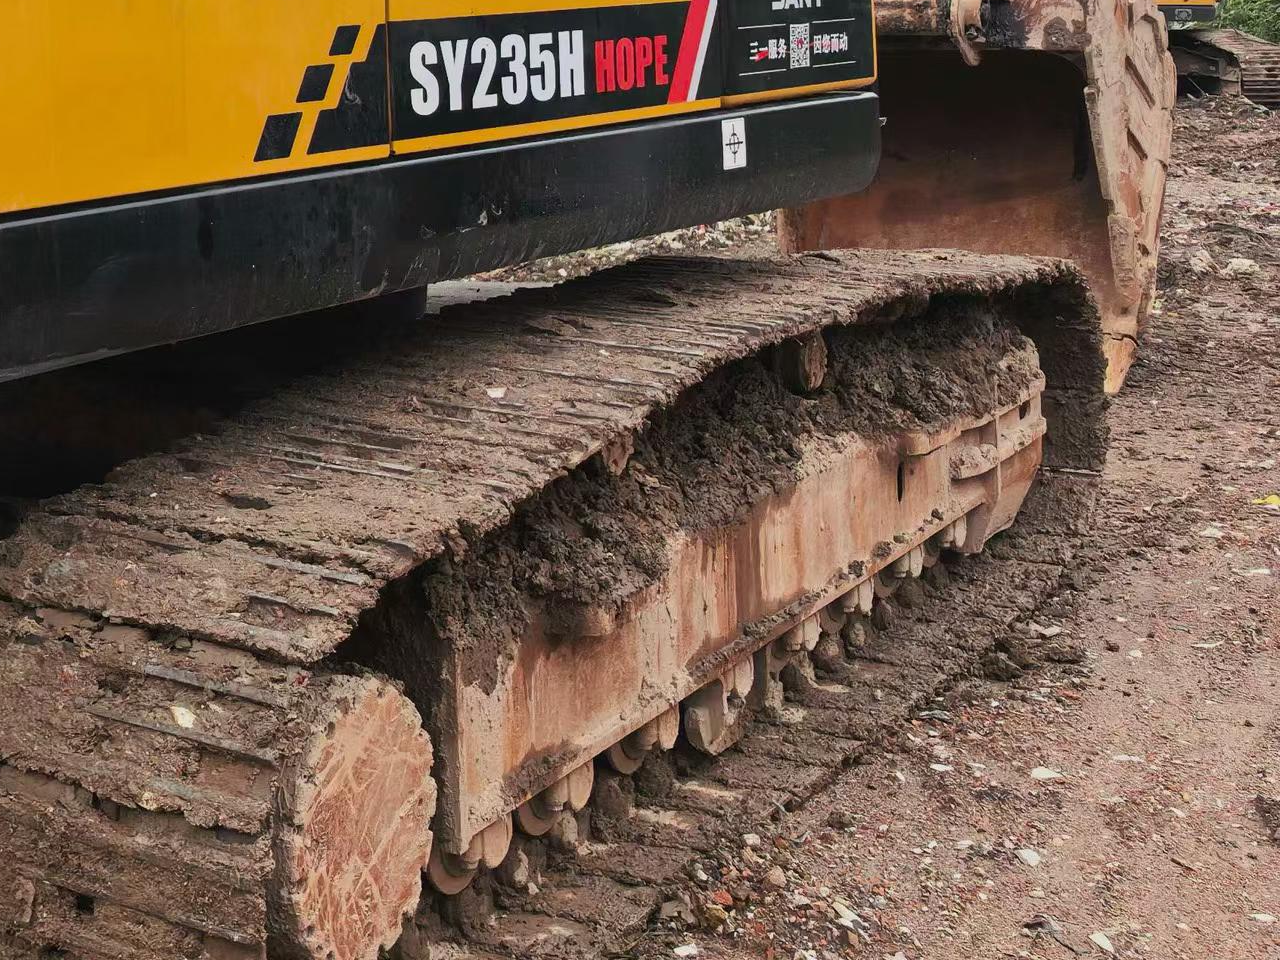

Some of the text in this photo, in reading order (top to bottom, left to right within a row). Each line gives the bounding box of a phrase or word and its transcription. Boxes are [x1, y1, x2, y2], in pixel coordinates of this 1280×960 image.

[409, 29, 670, 116] SY235H HOPE
[749, 31, 848, 60] 三一服务 因您而动
